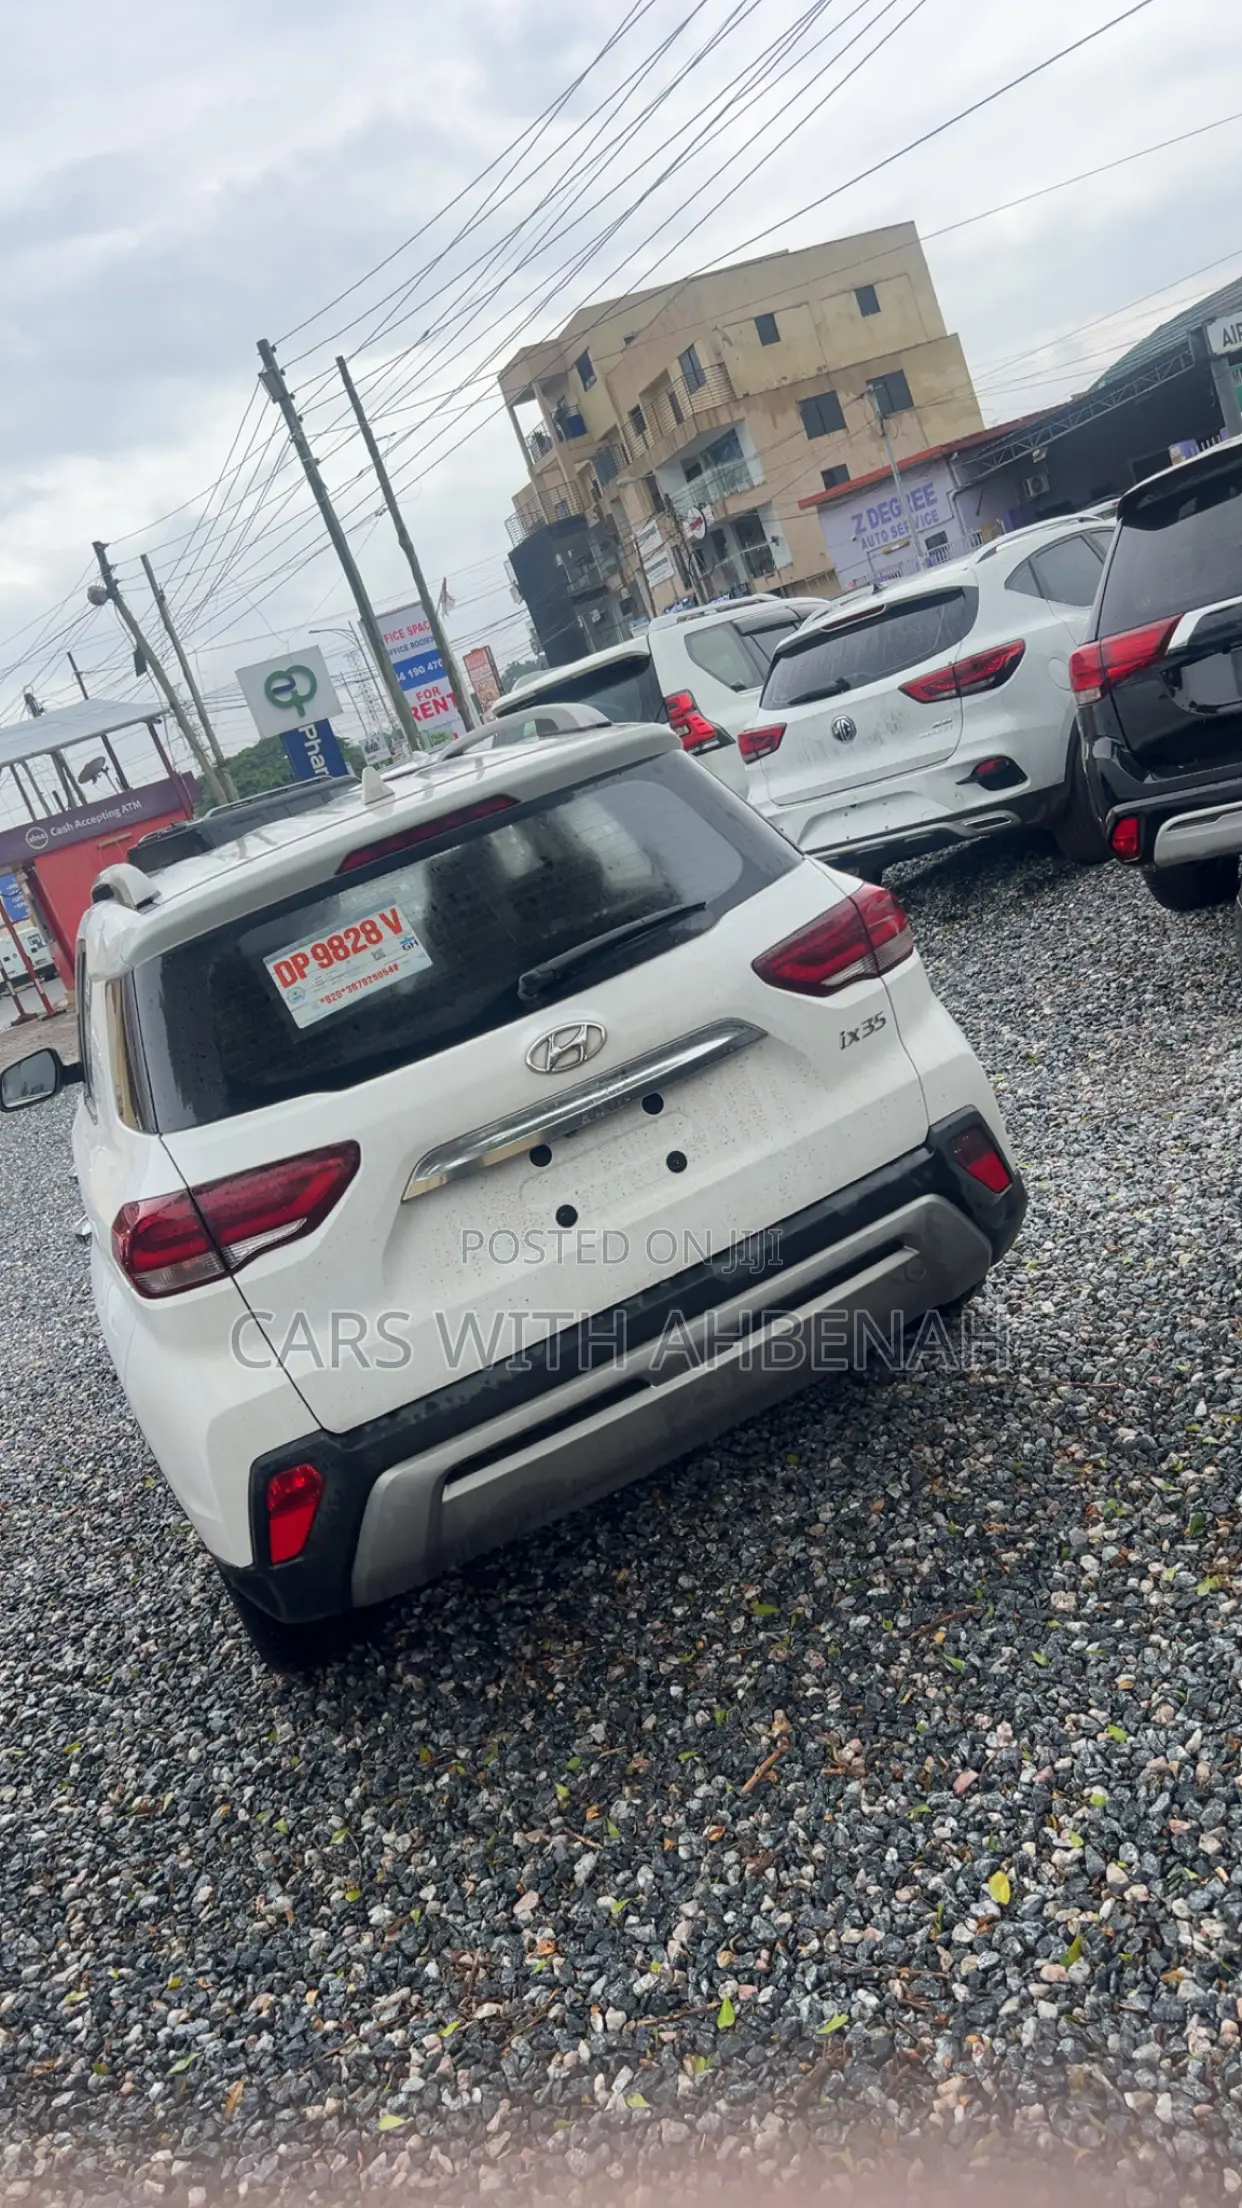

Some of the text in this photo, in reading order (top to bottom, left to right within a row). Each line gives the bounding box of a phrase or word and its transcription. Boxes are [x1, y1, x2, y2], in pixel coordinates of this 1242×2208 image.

[851, 482, 938, 535] Z DEGEE
[861, 530, 889, 551] AUTO
[383, 620, 431, 644] FICE SPAC
[408, 665, 425, 679] 190
[415, 686, 441, 702] FOR
[298, 723, 331, 777] Phar
[50, 822, 74, 838] Cash
[75, 807, 122, 829] Accepting
[121, 800, 142, 814] ATM
[273, 951, 310, 989] DP
[310, 919, 384, 969] 9828
[378, 907, 404, 936] V
[402, 938, 419, 952] GH
[840, 1010, 887, 1051] ix35
